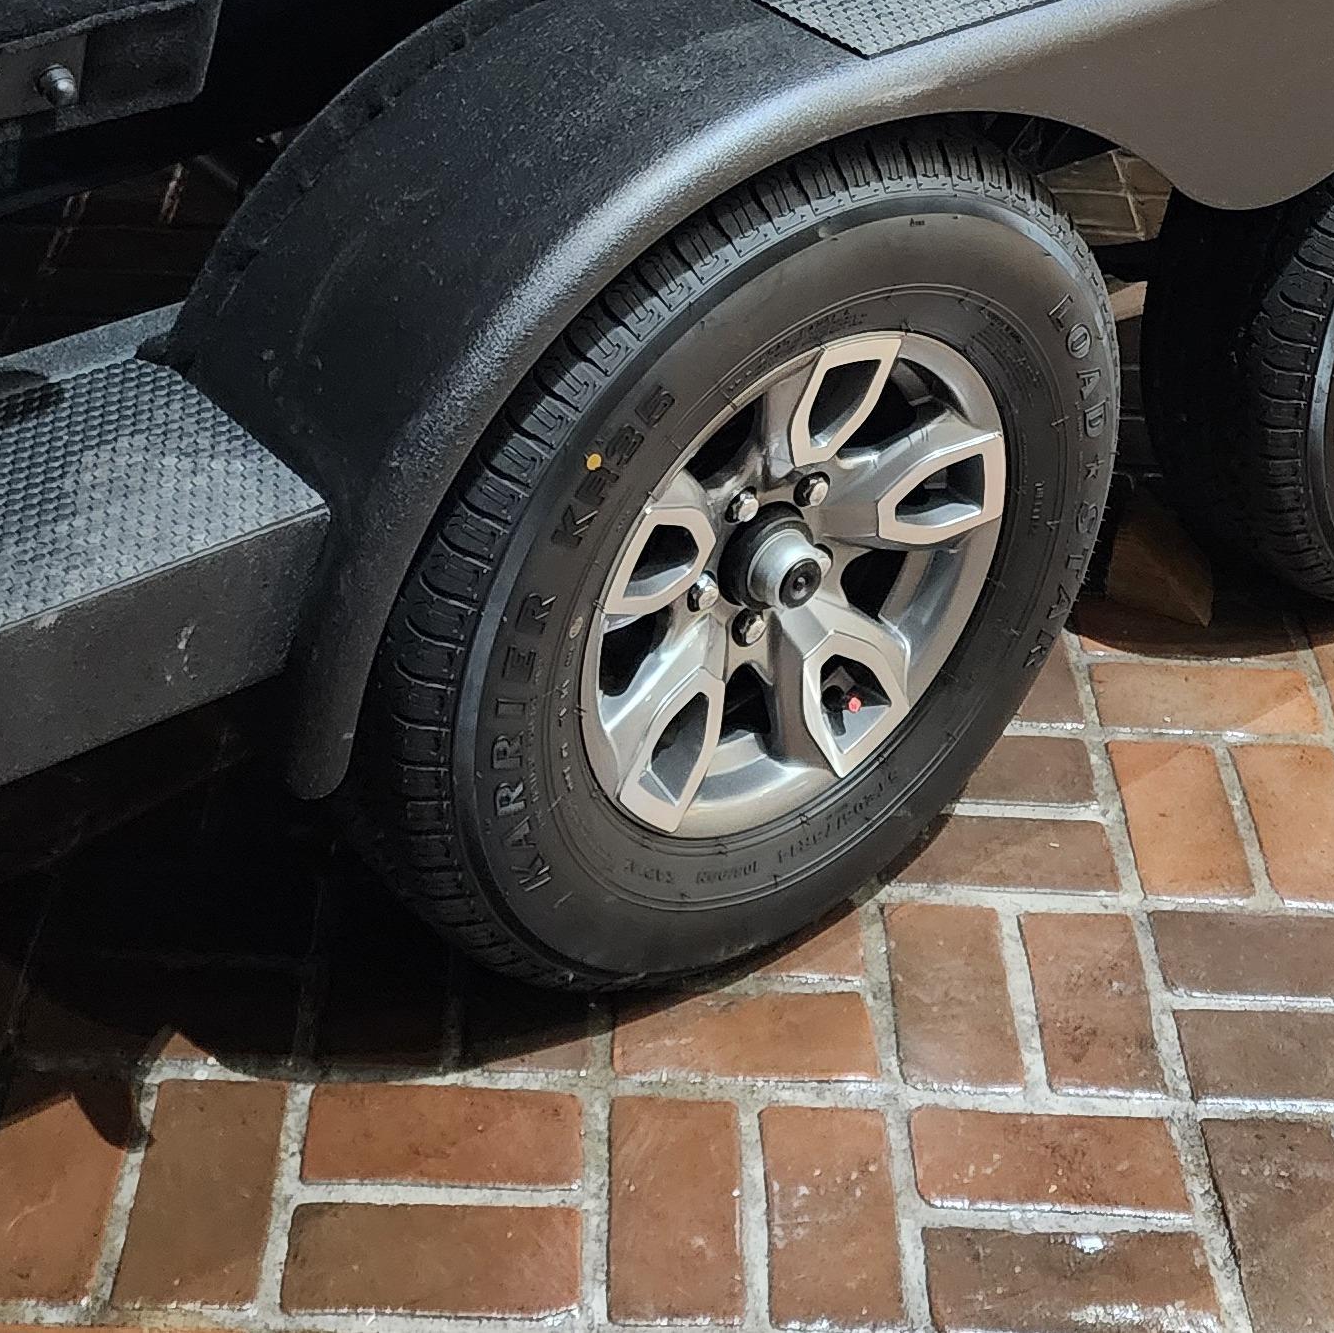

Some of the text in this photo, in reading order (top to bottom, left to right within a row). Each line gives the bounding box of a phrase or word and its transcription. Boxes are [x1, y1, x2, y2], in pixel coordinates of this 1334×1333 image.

[1022, 292, 1108, 669] LOAD STAR
[491, 593, 557, 895] KARRIER
